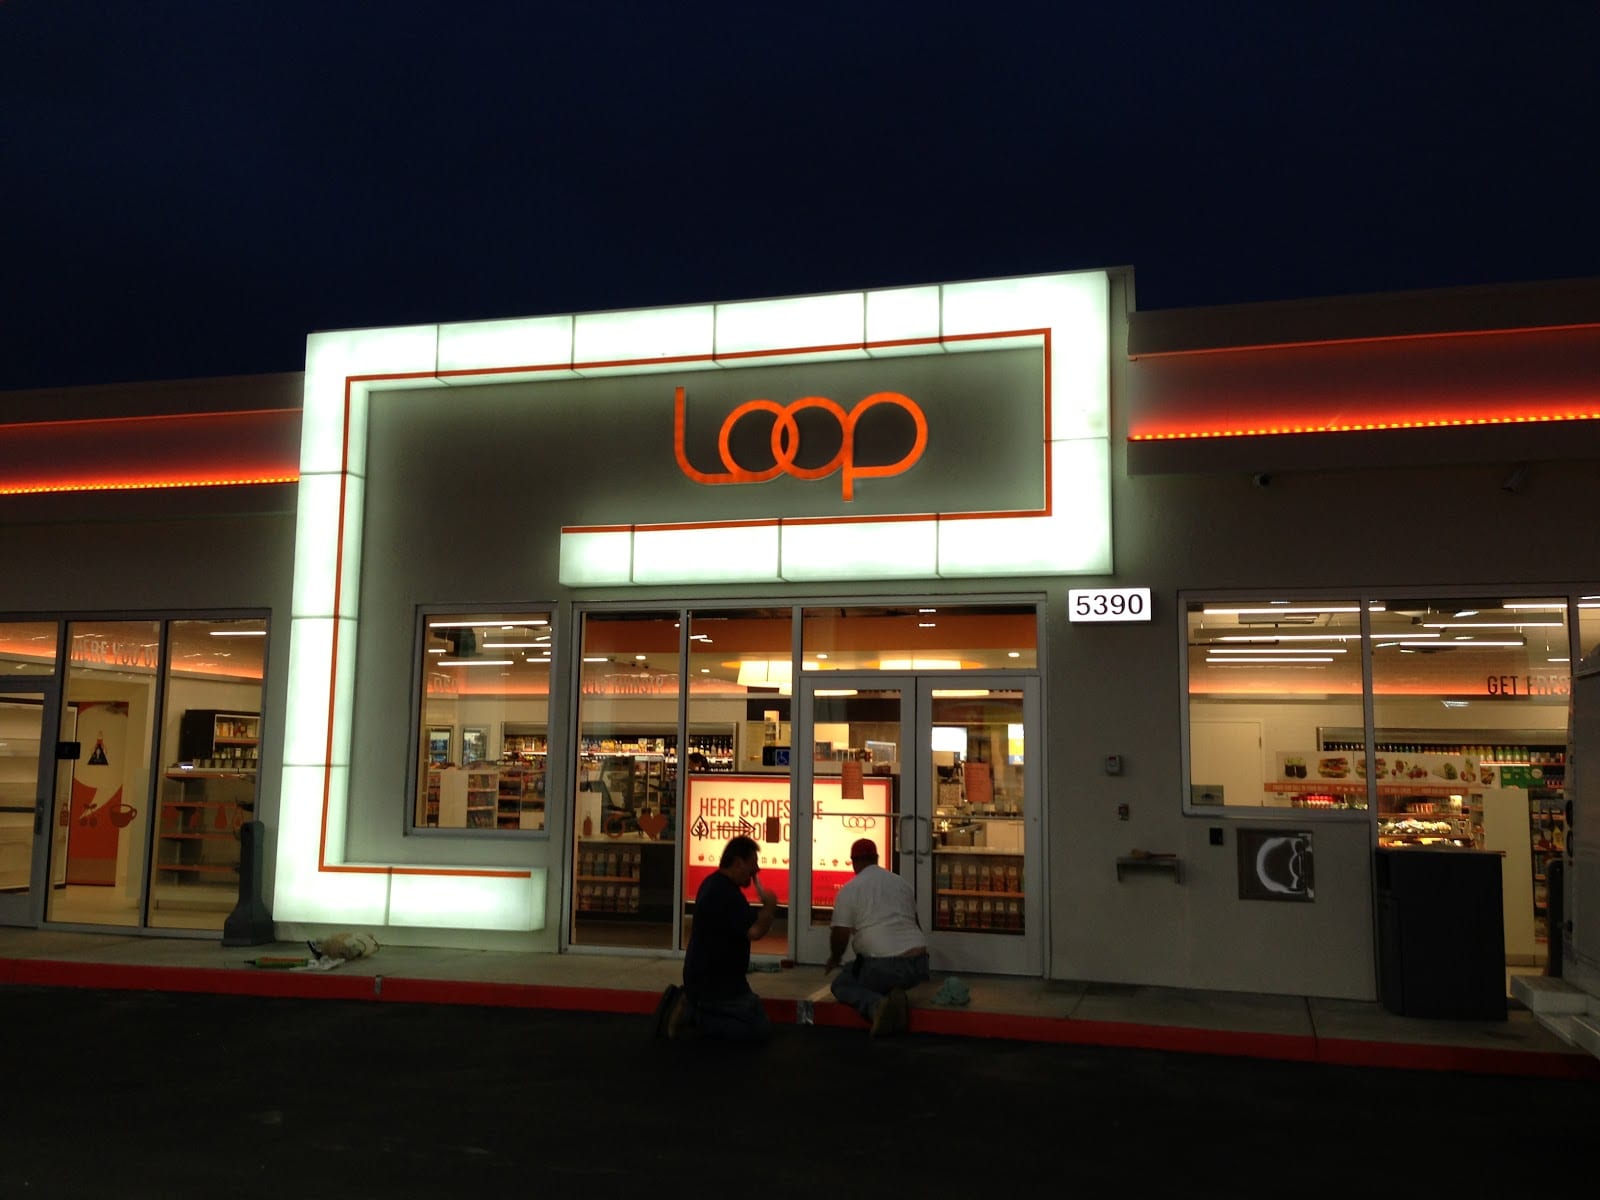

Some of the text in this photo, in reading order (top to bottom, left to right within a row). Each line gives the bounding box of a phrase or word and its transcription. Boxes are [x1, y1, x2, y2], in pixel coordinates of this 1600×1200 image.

[1076, 593, 1144, 616] 5390
[1487, 674, 1518, 696] GET
[699, 797, 735, 817] HERE
